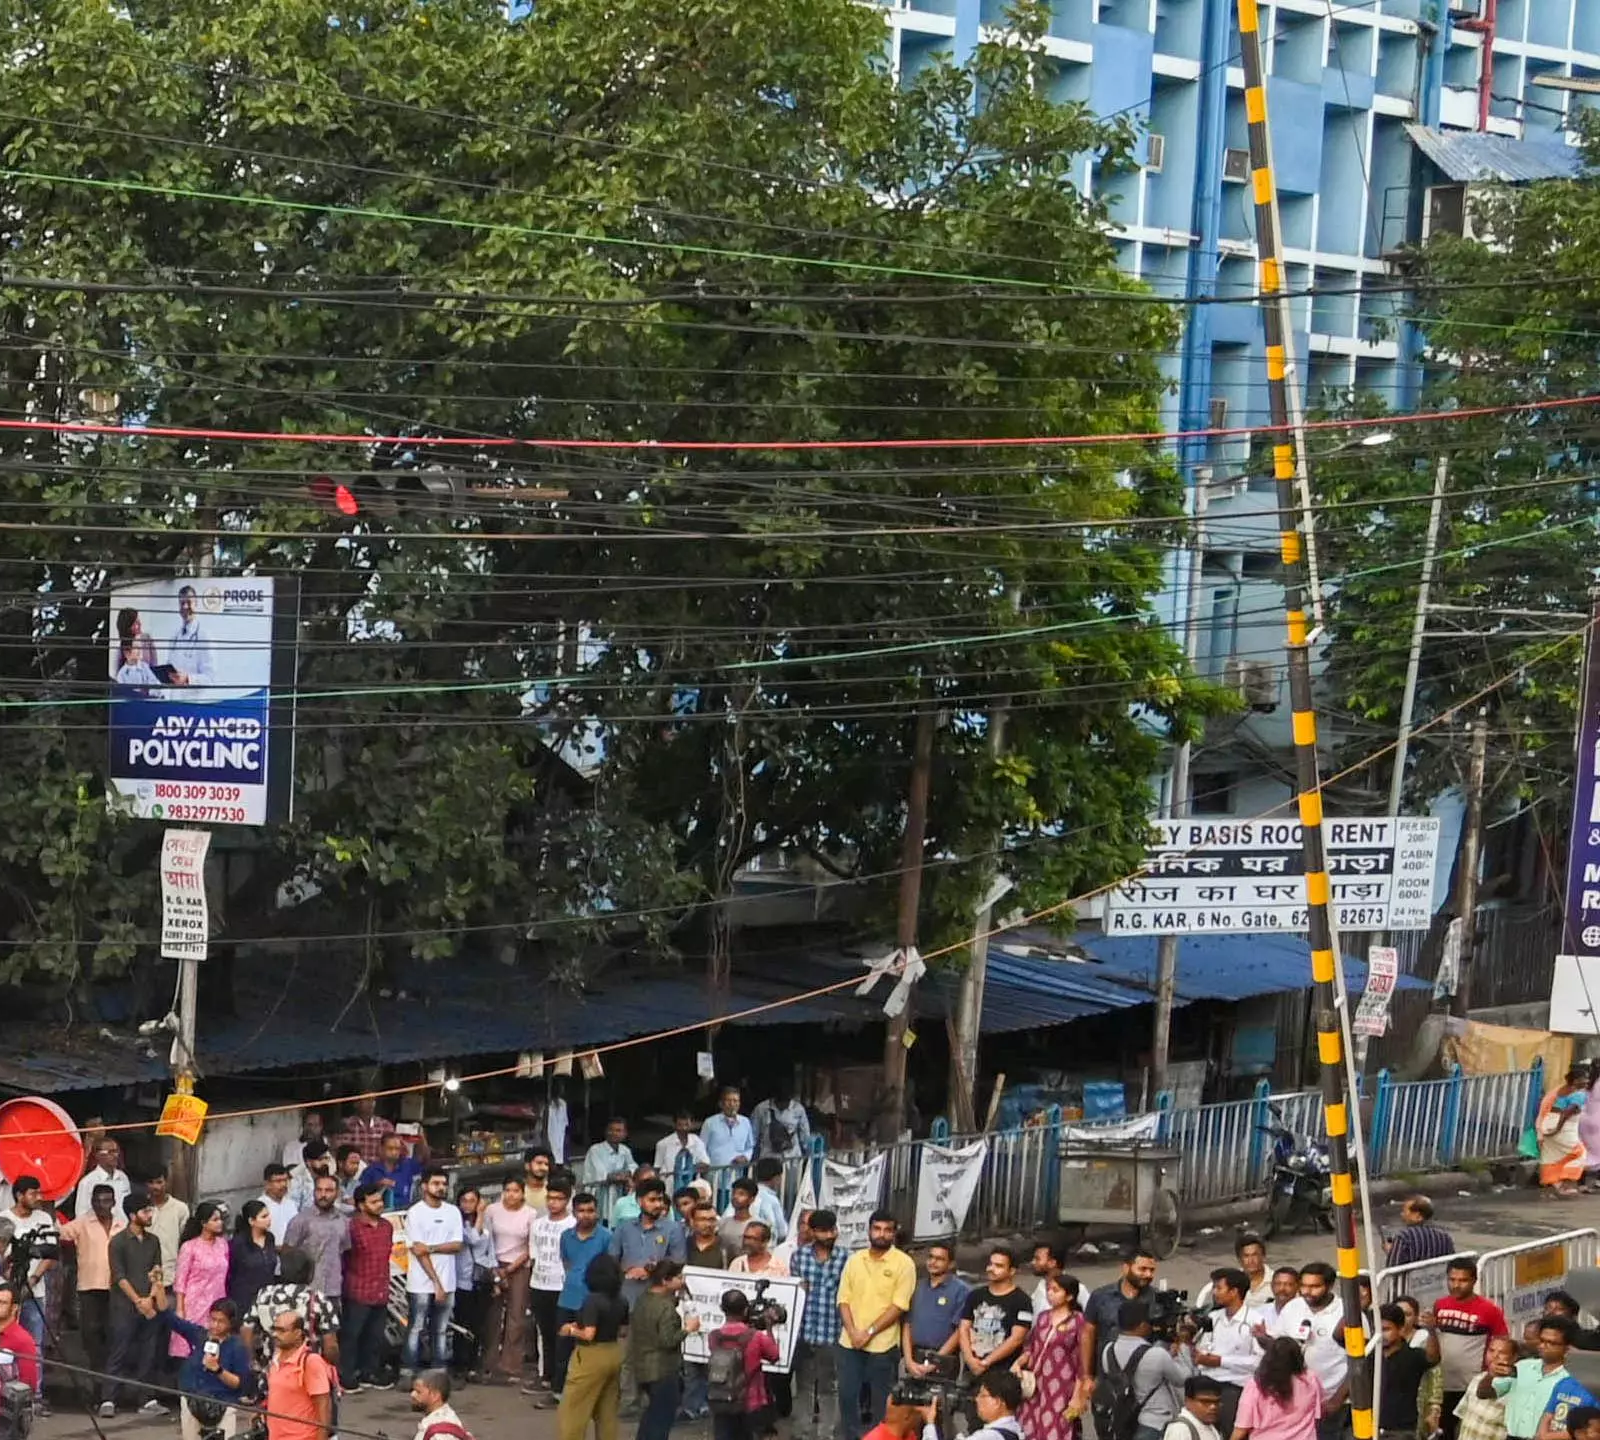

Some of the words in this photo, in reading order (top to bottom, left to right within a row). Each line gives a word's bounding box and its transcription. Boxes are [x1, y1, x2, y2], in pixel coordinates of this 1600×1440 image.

[223, 589, 264, 602] PROBE
[152, 715, 261, 739] ADVANCED
[128, 739, 260, 770] POLYCLINIC
[154, 783, 182, 798] 1800
[183, 785, 207, 799] 309
[208, 786, 240, 801] 3039
[167, 804, 245, 822] 9832977530
[1189, 821, 1253, 847] BASIS
[1261, 823, 1304, 846] ROO
[1330, 822, 1389, 844] RENT
[1400, 849, 1434, 860] CABIN
[1241, 855, 1289, 874] ঘর
[1121, 878, 1180, 903] रोज
[1196, 884, 1236, 902] का
[1252, 884, 1300, 900] घर
[1398, 878, 1430, 888] ROOM
[167, 918, 204, 929] XEROX
[1114, 913, 1149, 930] R.G.
[1197, 912, 1206, 929] 6
[1210, 911, 1237, 928] No.
[1241, 910, 1283, 929] Gate,
[1339, 907, 1384, 925] 82673
